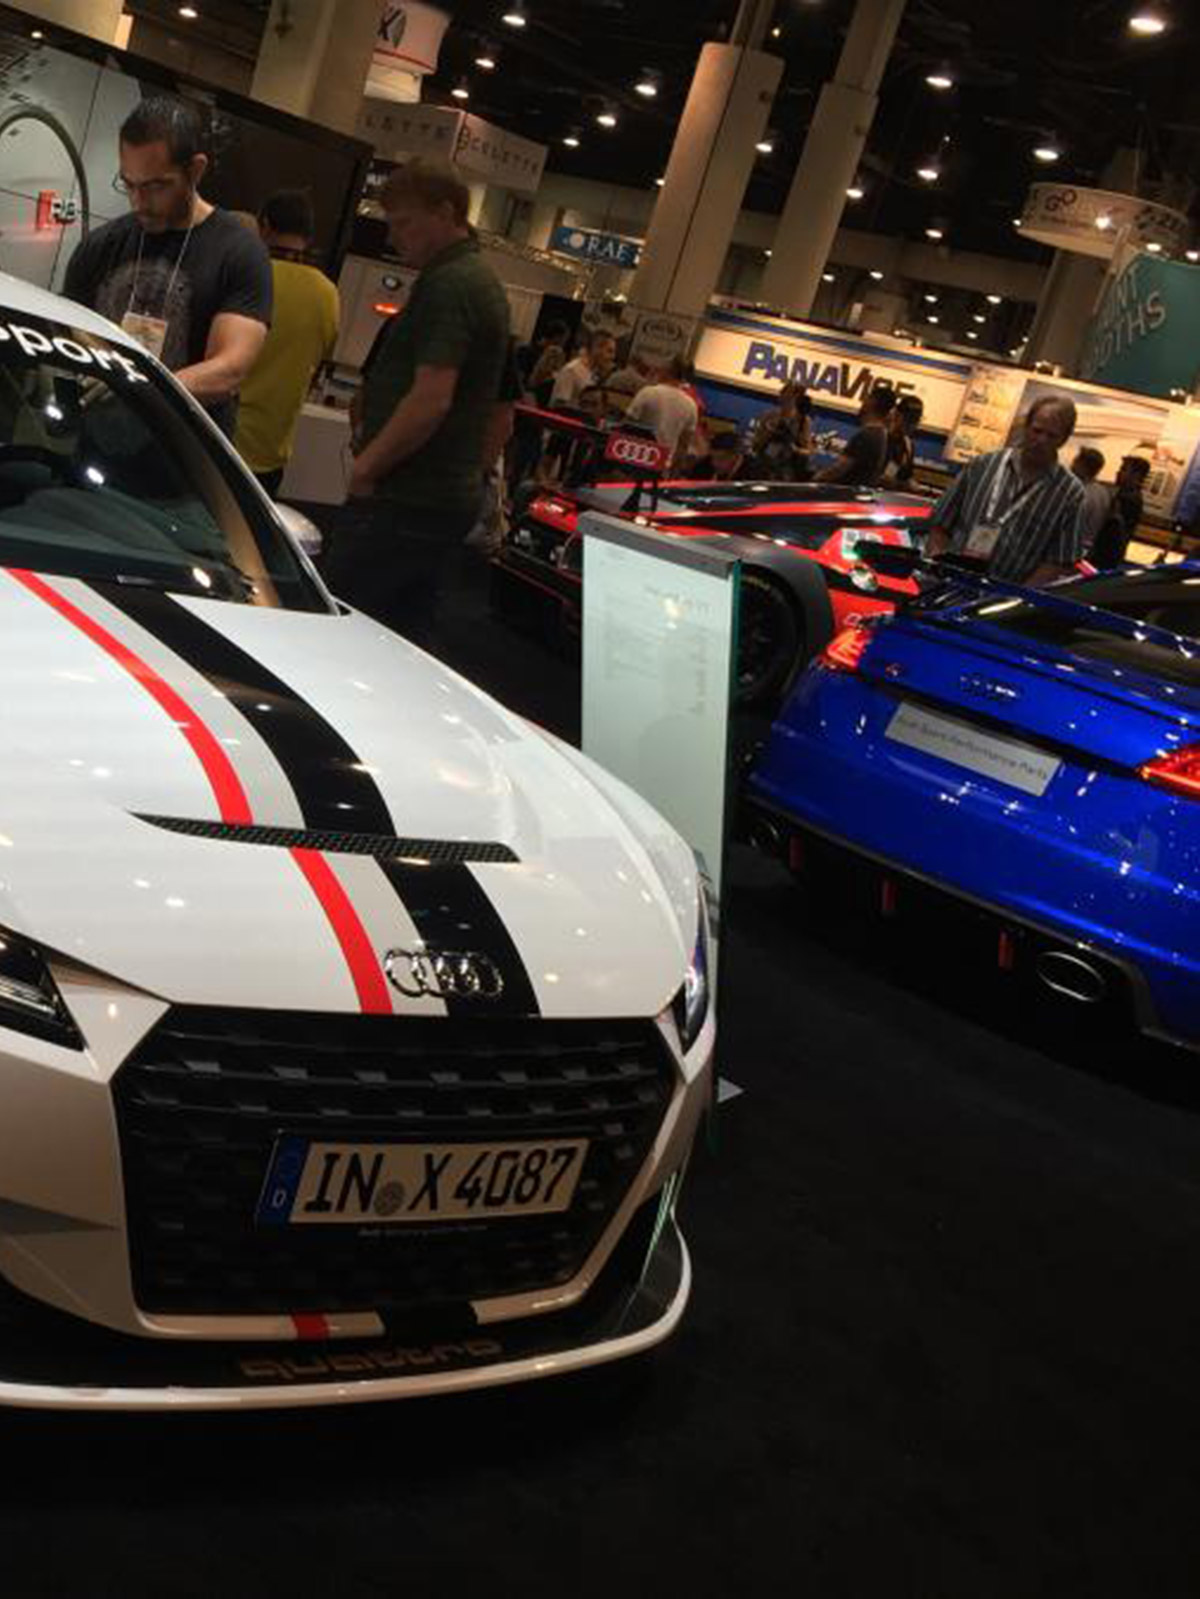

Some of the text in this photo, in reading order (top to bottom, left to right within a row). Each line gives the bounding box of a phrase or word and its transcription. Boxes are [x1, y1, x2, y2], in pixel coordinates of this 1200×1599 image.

[303, 1152, 384, 1214] IN
[406, 1152, 453, 1212] X
[453, 1147, 580, 1208] 4087
